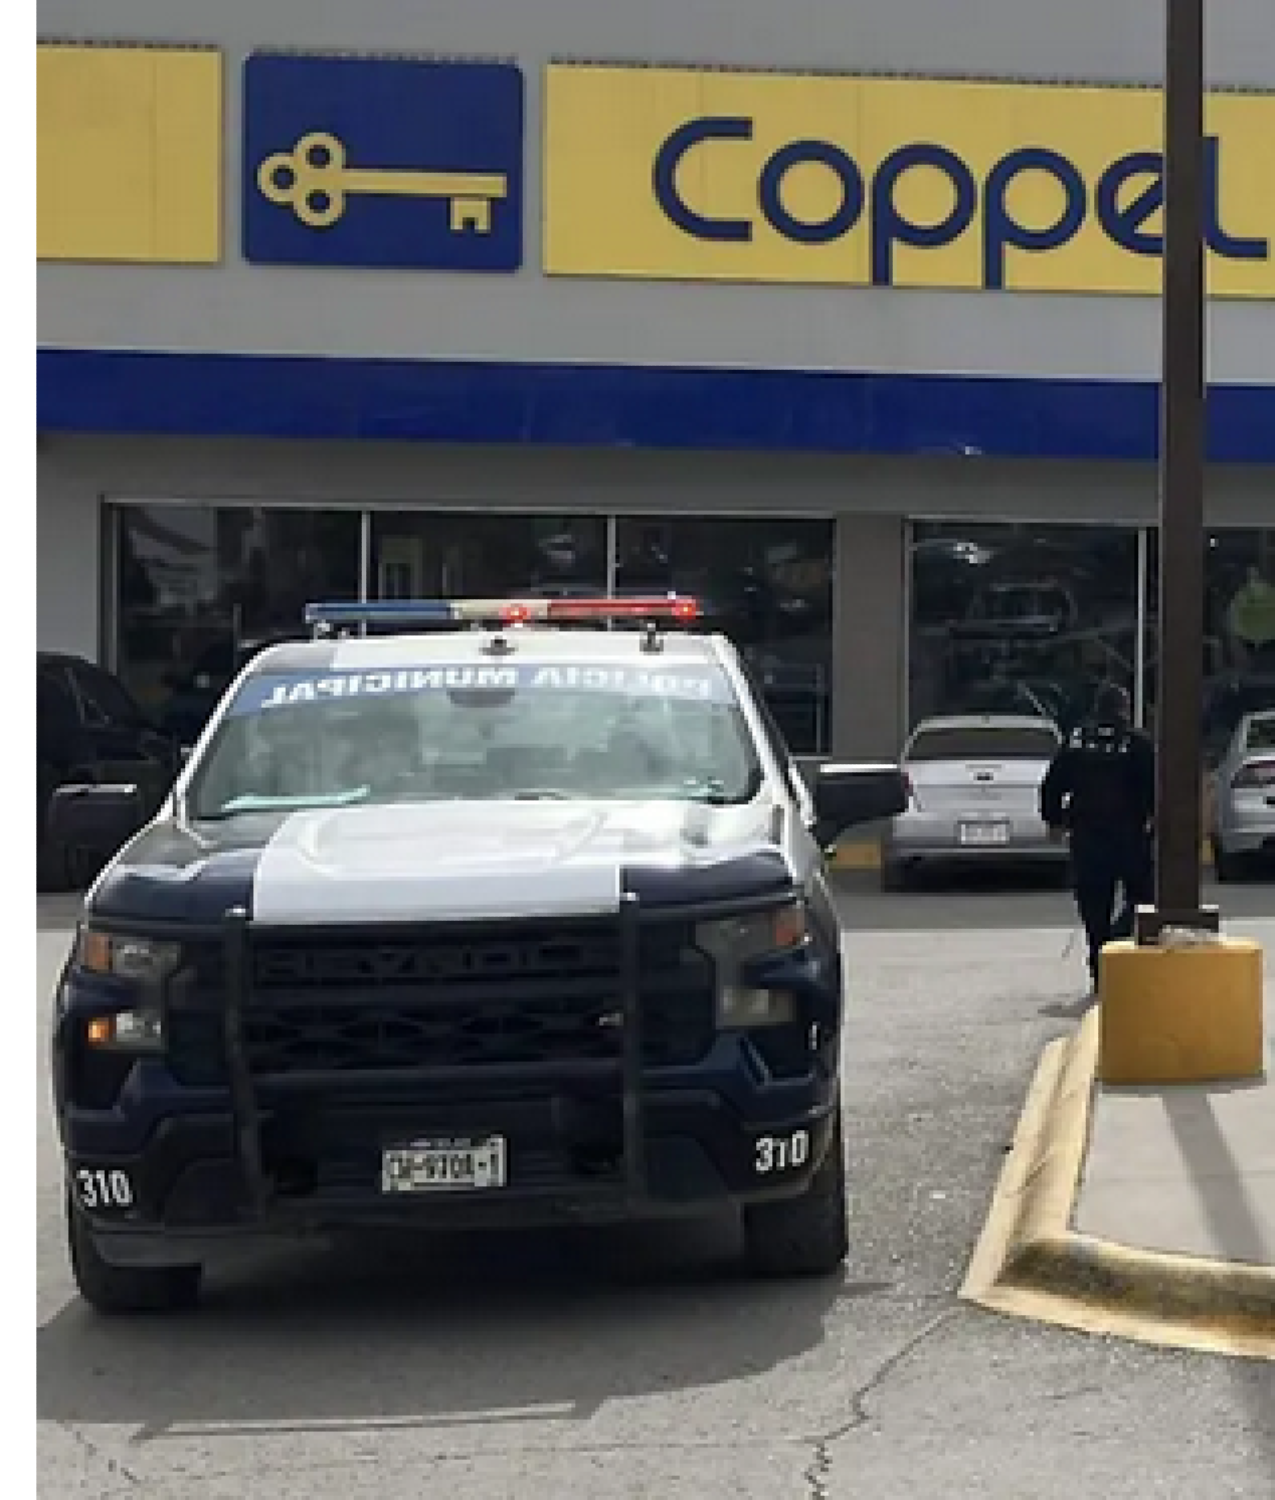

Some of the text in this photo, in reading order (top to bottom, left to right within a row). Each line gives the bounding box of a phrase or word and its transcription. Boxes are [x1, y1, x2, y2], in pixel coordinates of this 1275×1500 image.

[653, 116, 1268, 289] Coppel
[755, 1130, 809, 1172] 310
[77, 1169, 133, 1207] 310
